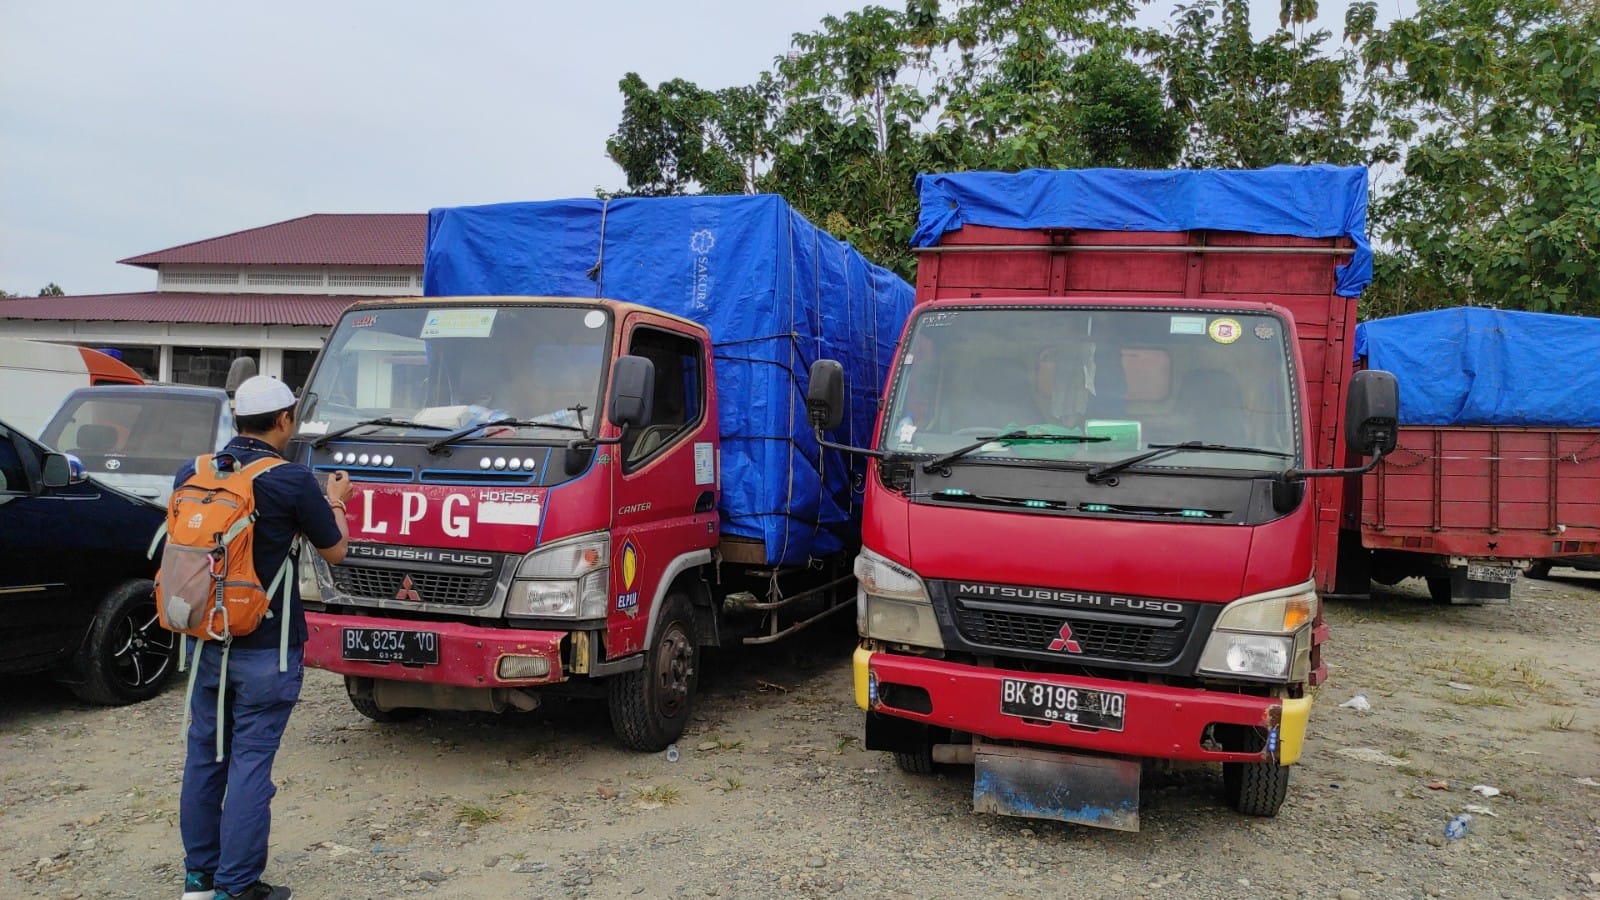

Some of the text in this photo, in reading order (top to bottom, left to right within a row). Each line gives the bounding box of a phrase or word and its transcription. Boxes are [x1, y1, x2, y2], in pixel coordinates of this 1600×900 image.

[696, 256, 708, 309] SAKURA
[479, 491, 540, 503] HD125PS
[618, 502, 652, 515] CANTER
[347, 545, 493, 566] TSUBISHI FUSO
[959, 584, 1183, 613] MITSUBISHI FUSO
[346, 629, 364, 649] BK
[372, 631, 405, 651] 8254
[1004, 681, 1027, 704] BK
[1032, 685, 1079, 711] 8196
